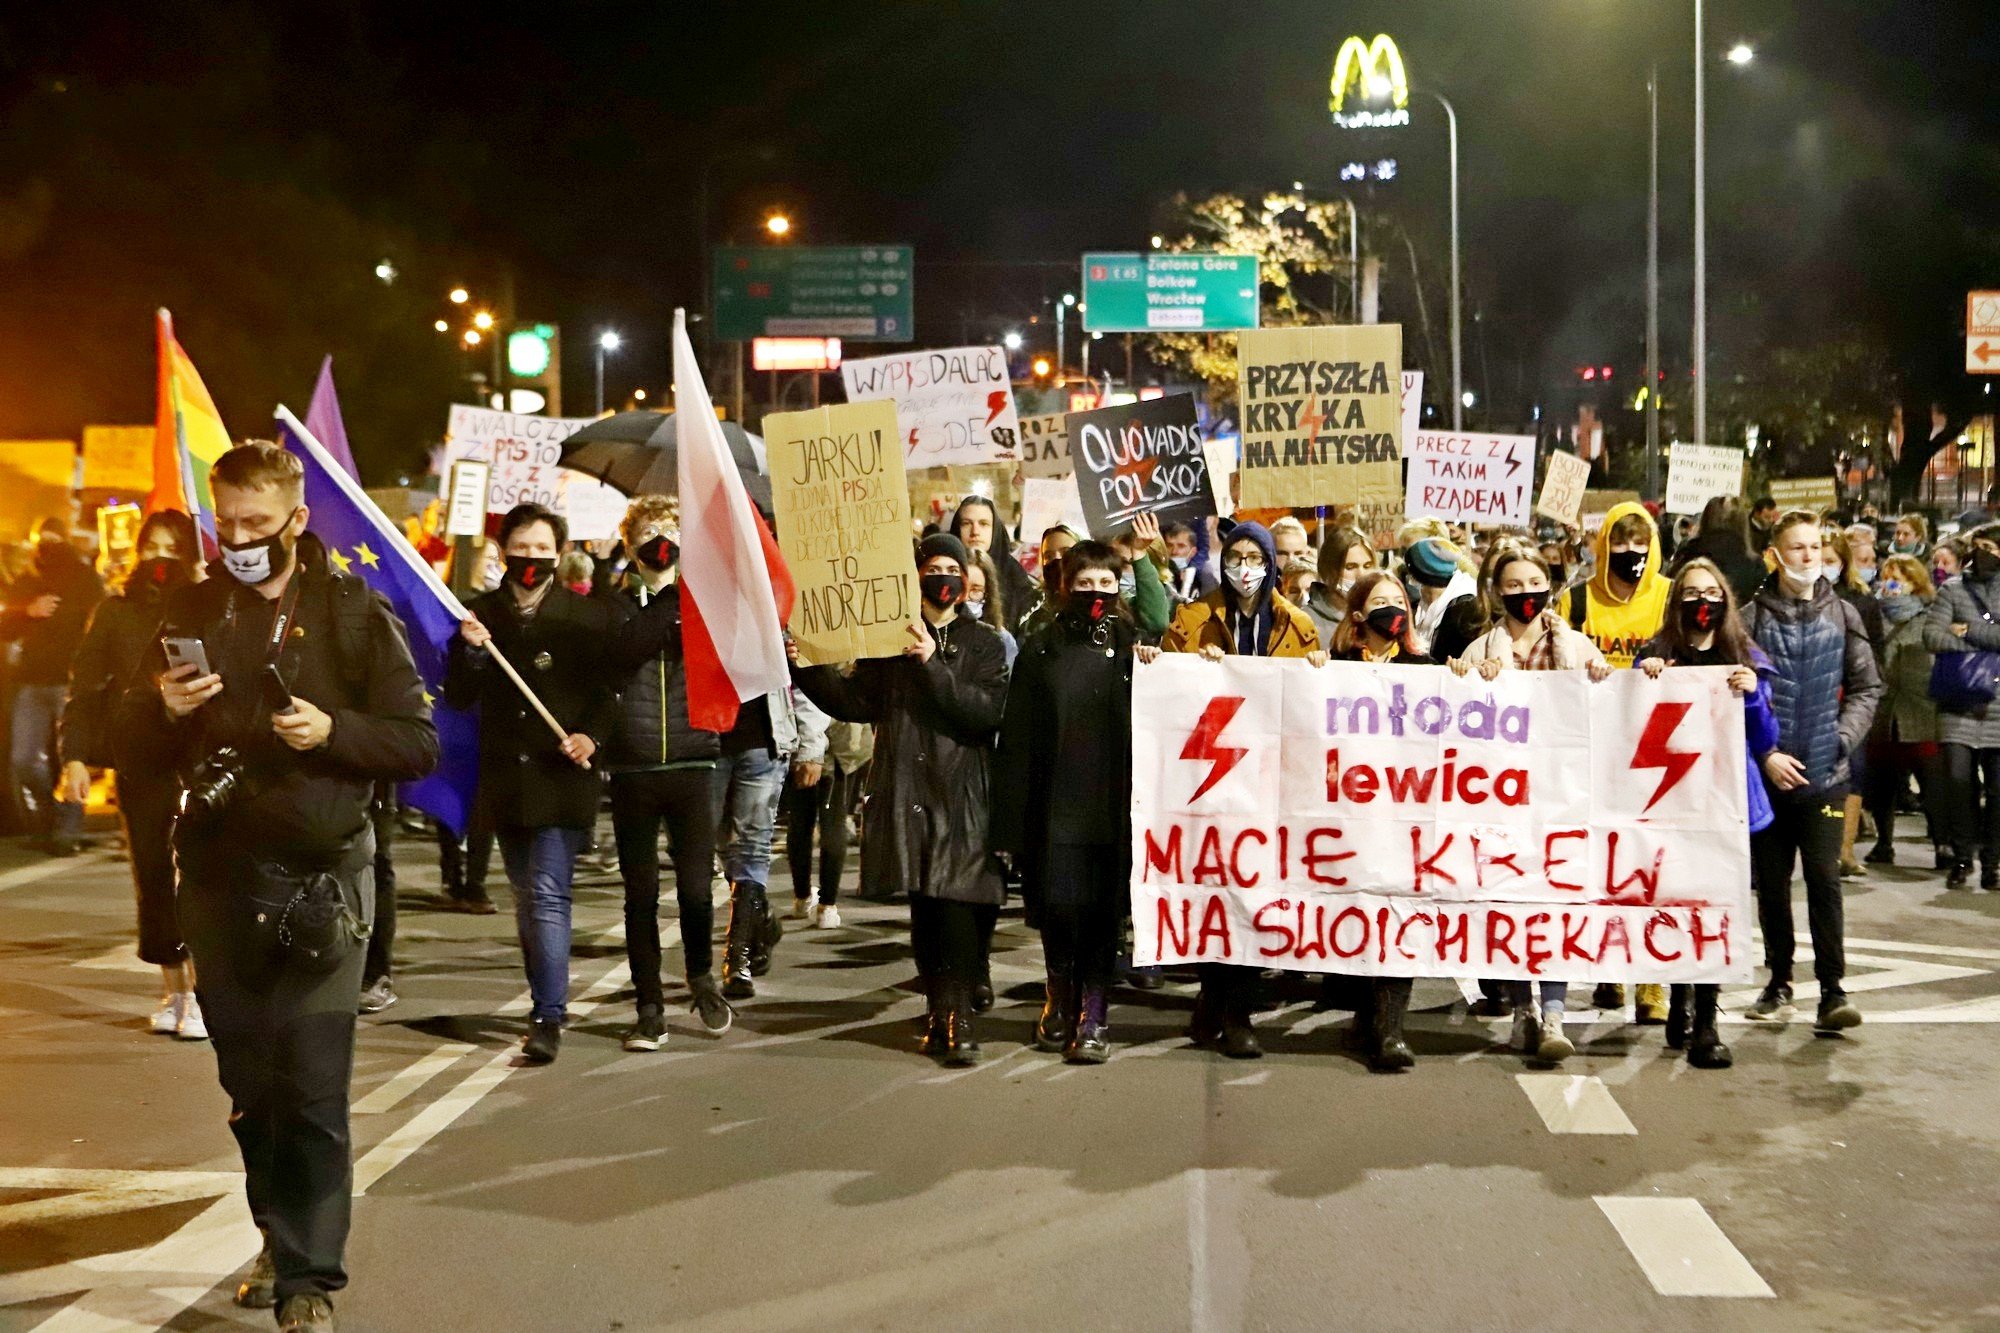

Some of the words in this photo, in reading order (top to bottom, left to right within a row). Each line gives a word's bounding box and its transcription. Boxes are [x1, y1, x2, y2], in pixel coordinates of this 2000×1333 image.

[1147, 274, 1197, 288] Bolków
[1148, 257, 1199, 271] Zielona
[1147, 291, 1206, 305] Wrocław
[1246, 360, 1390, 400] PRZYSZŁA
[787, 429, 885, 485] JARKU!
[1080, 423, 1146, 474] QUO
[1246, 440, 1280, 469] NA
[1282, 432, 1400, 467] MATYSKA
[1416, 435, 1472, 456] PRECZ
[1487, 440, 1500, 458] Z
[1099, 456, 1206, 510] POLSKO?
[826, 556, 859, 583] TO
[801, 573, 911, 636] ANDRZEJ!
[1326, 683, 1530, 744] młoda
[1326, 747, 1530, 806] lewica
[1143, 824, 1357, 889] MACIE
[1410, 825, 1665, 904] KREW
[1155, 894, 1232, 962] NA
[1252, 897, 1469, 964] SWOICH
[1485, 906, 1731, 975] RĘKACH
